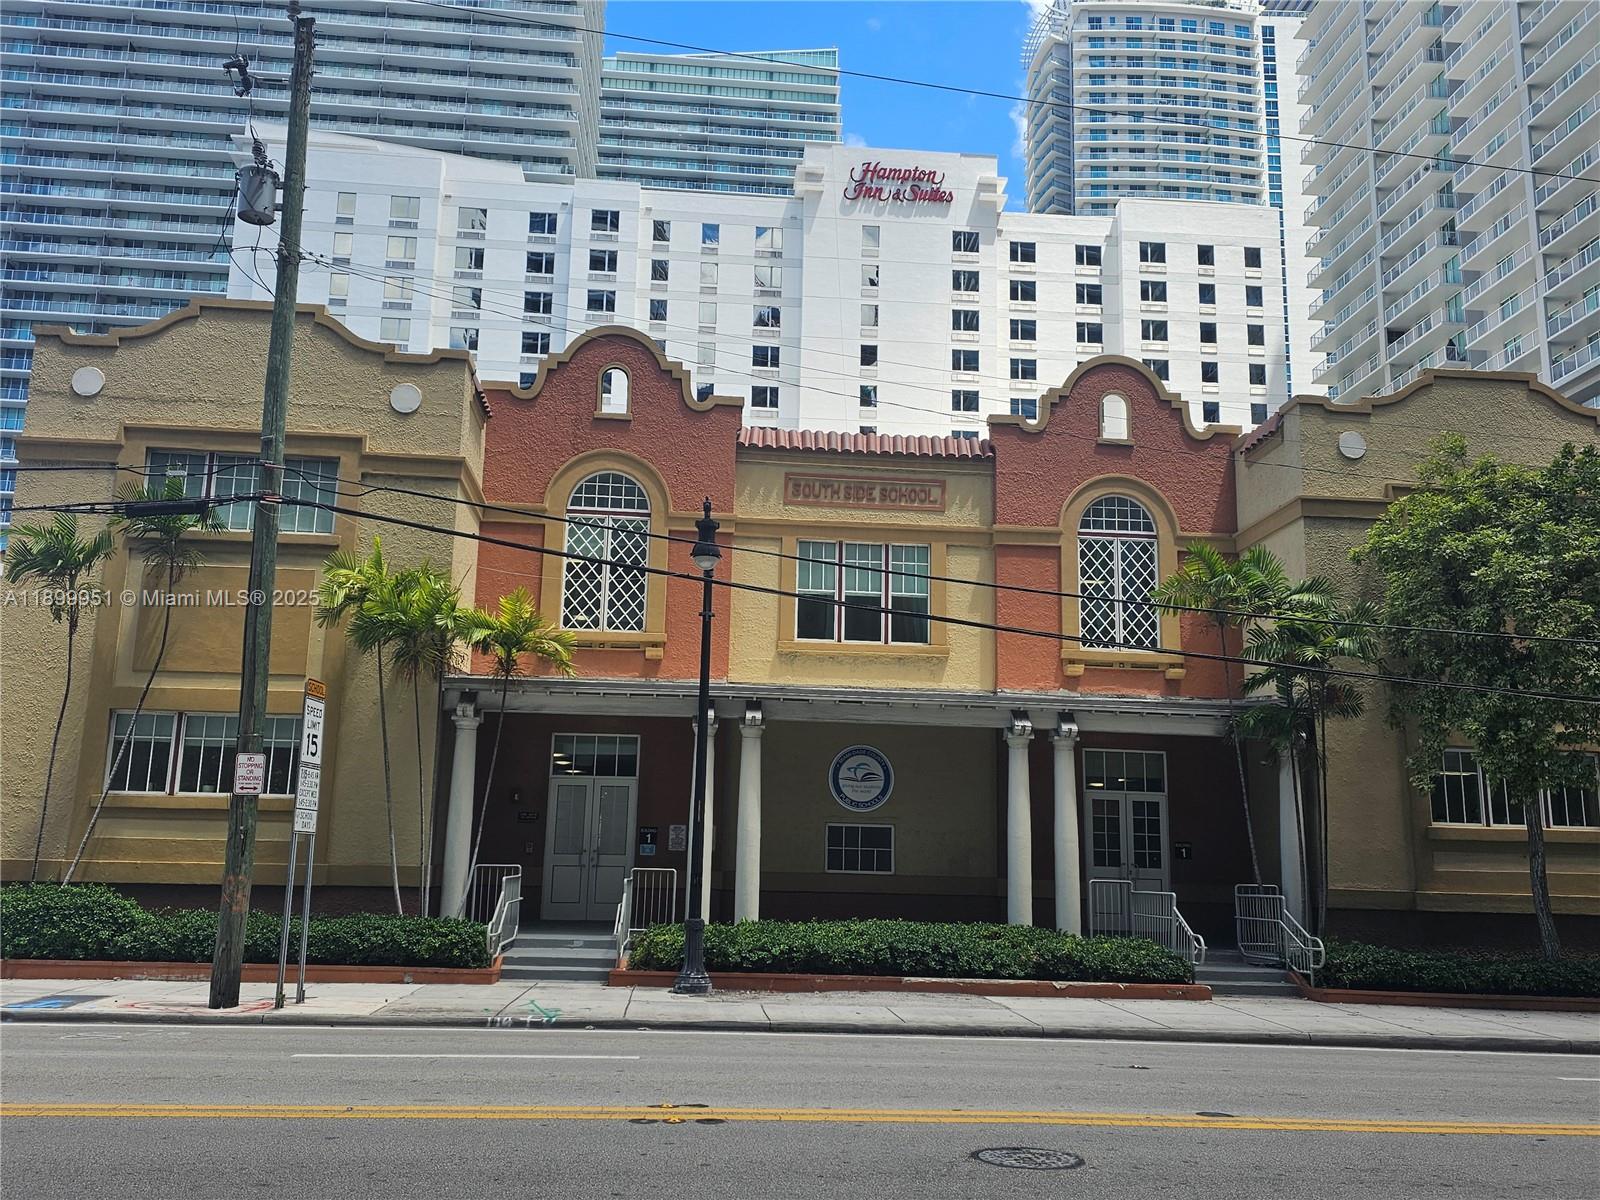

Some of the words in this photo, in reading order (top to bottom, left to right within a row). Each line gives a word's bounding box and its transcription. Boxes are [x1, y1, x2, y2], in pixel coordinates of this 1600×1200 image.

[850, 161, 945, 184] Hampton
[843, 182, 891, 202] Inn
[891, 188, 904, 202] &
[903, 184, 954, 202] Suites
[791, 480, 841, 500] SOUTH
[843, 484, 877, 502] SIDE
[879, 485, 938, 504] SCHOOL
[308, 681, 326, 696] SCHOOL
[306, 704, 323, 719] SPEED
[306, 719, 321, 732] LIMIT
[306, 732, 319, 757] 15
[300, 811, 313, 820] SCHOOL
[301, 820, 311, 829] DAYS
[645, 833, 651, 844] 1
